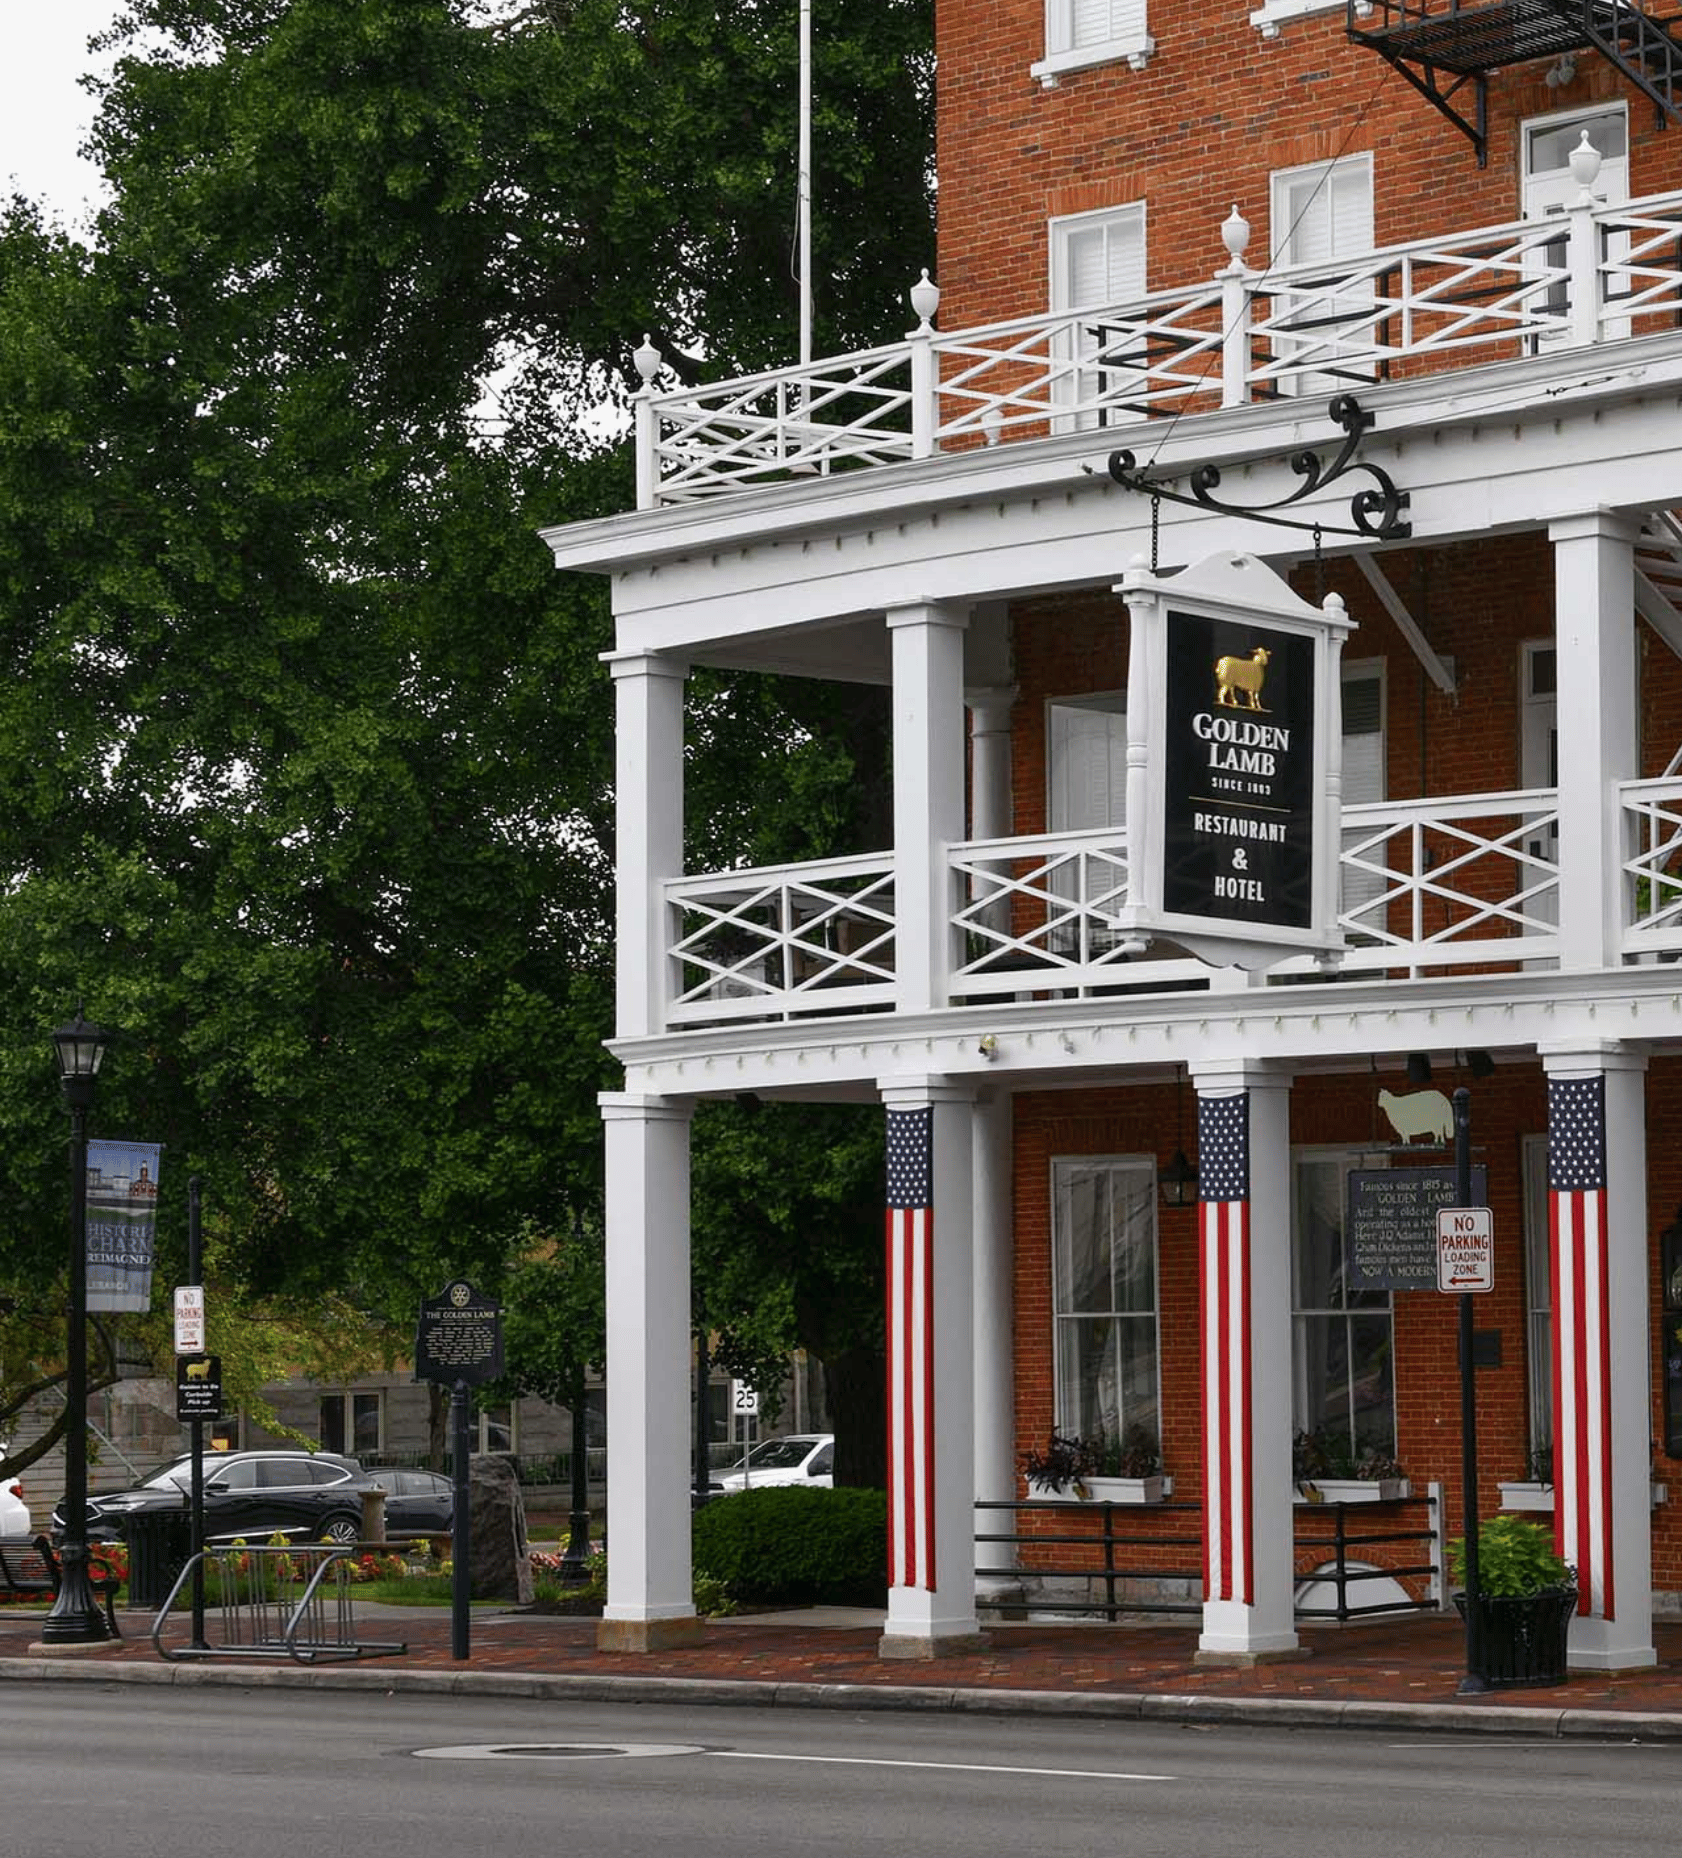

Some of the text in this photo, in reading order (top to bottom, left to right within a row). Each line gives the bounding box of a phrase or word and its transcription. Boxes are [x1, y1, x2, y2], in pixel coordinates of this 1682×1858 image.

[1193, 713, 1290, 751] GOLDEN
[1207, 742, 1276, 776] LAMB
[1211, 777, 1243, 791] SINCE
[1194, 813, 1287, 843] RESTAURANT
[1231, 848, 1248, 870] &
[1214, 876, 1265, 901] HOTEL
[1454, 1216, 1475, 1232] NO
[1442, 1235, 1488, 1250] PARKING
[1444, 1251, 1486, 1263] LOADING
[1452, 1264, 1478, 1275] ZONE
[183, 1293, 195, 1305] NO
[425, 1311, 495, 1319] THE GOLDEN LAMB
[736, 1390, 755, 1408] 25
